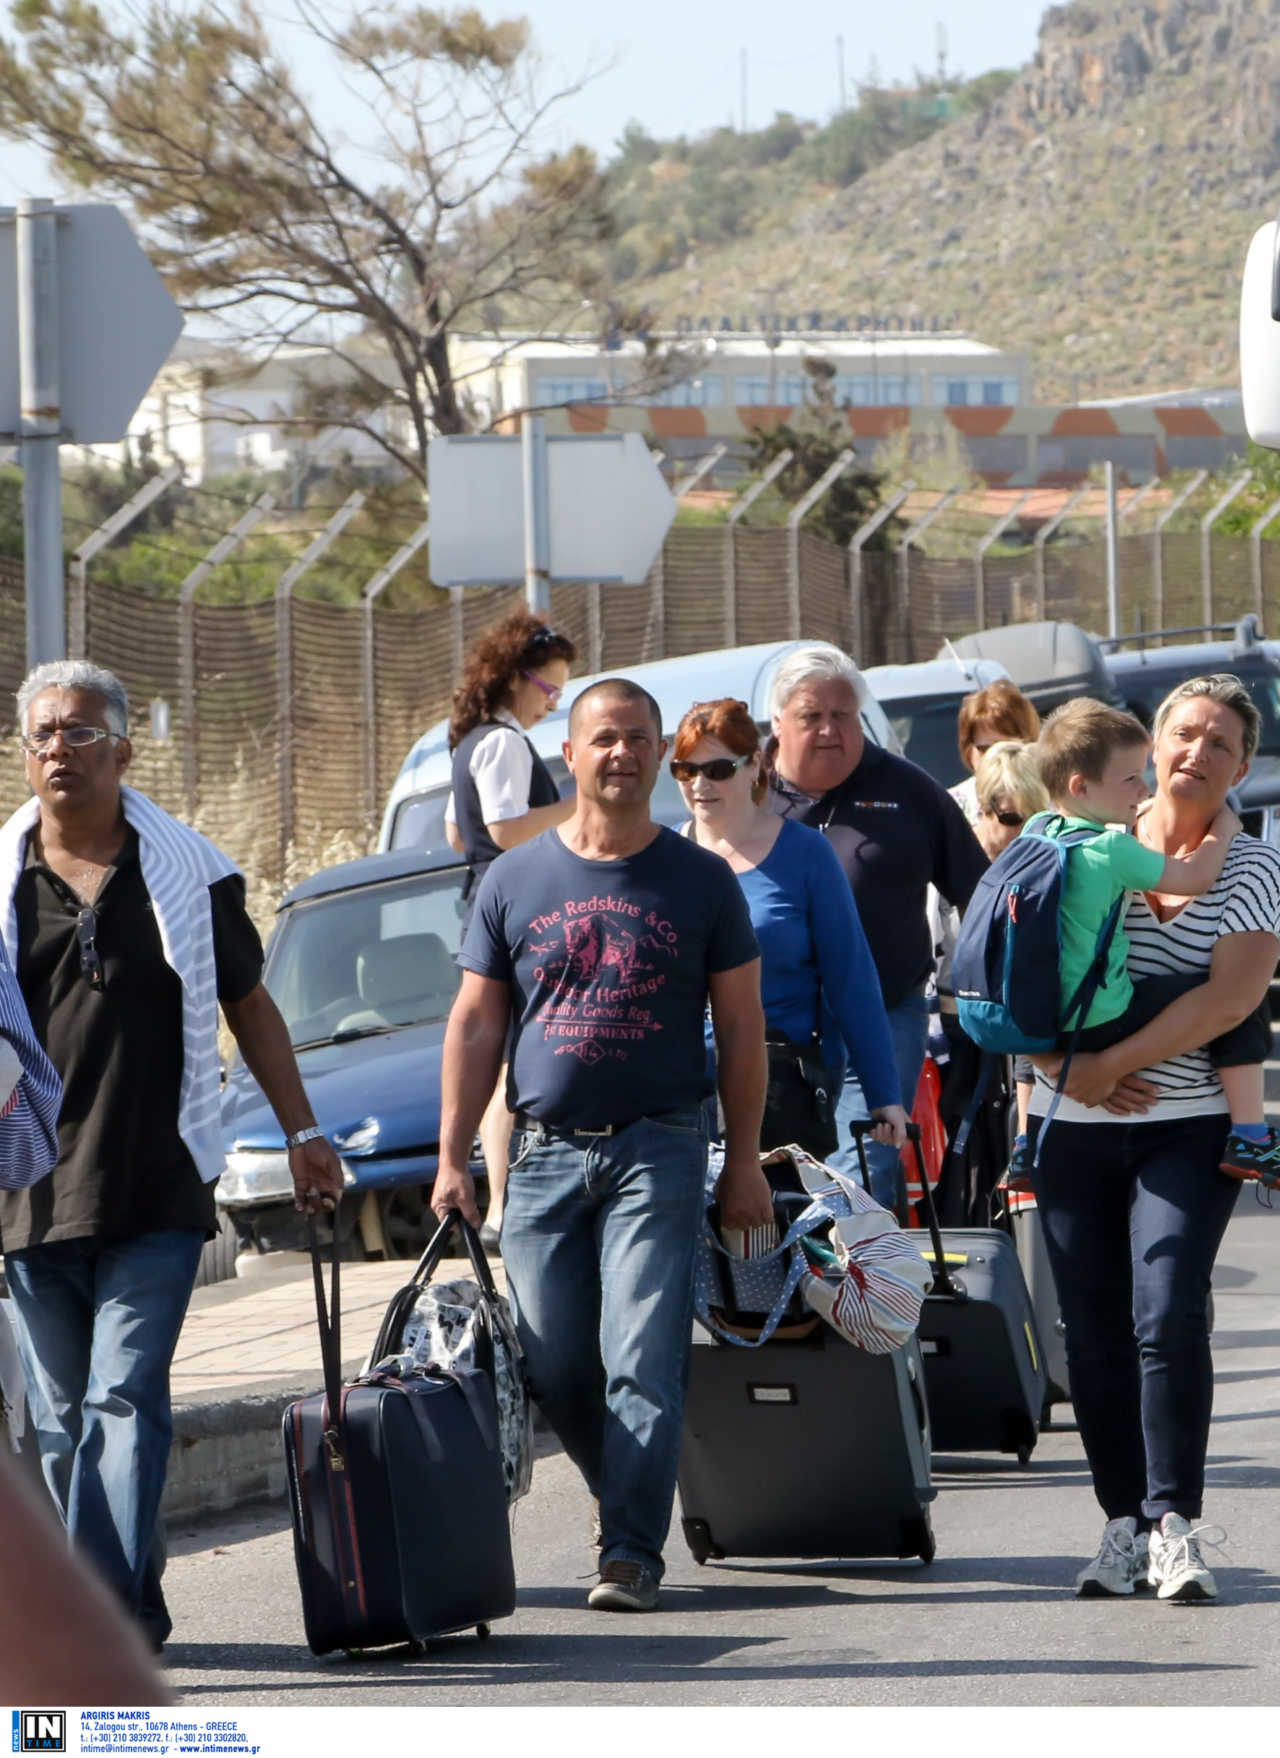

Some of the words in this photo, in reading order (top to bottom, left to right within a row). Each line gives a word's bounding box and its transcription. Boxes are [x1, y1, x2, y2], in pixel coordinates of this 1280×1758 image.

[528, 910, 562, 935] The
[564, 895, 642, 918] Redskins
[596, 974, 666, 1002] Heritage
[582, 1003, 624, 1018] Goods
